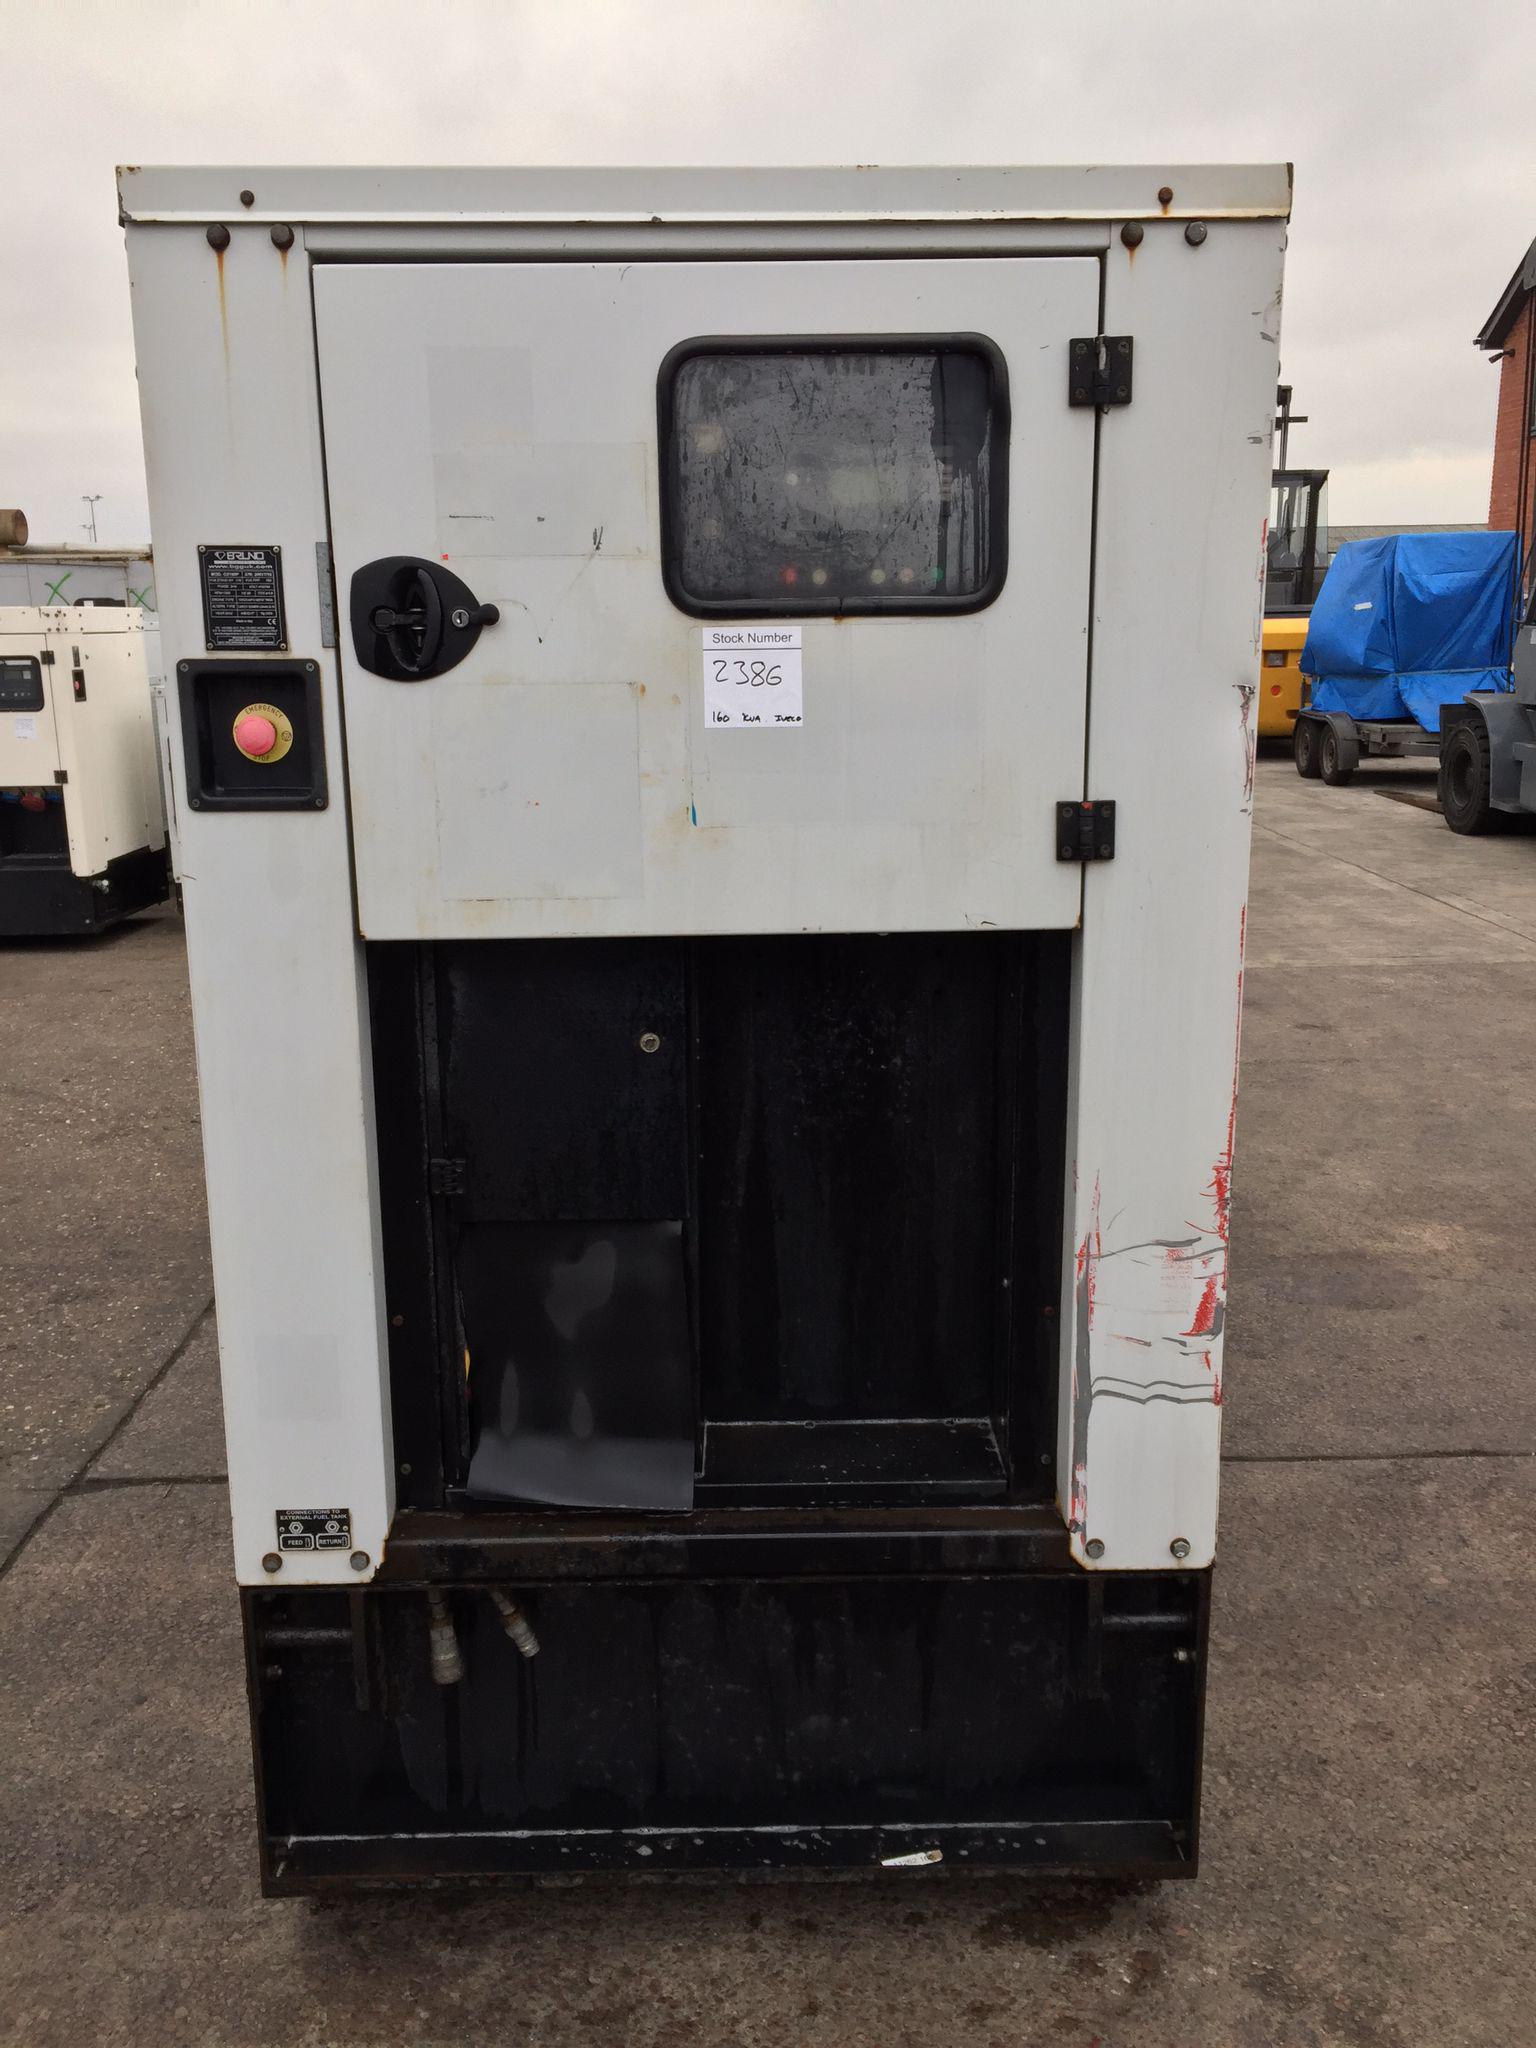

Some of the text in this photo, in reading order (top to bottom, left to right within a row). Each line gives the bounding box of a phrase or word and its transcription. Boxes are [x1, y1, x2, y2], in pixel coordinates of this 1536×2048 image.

[226, 551, 265, 560] BRUNO
[712, 632, 793, 644] Stock Number
[712, 659, 782, 687] 2386
[245, 704, 284, 719] EMERGENCY
[712, 711, 730, 722] 160
